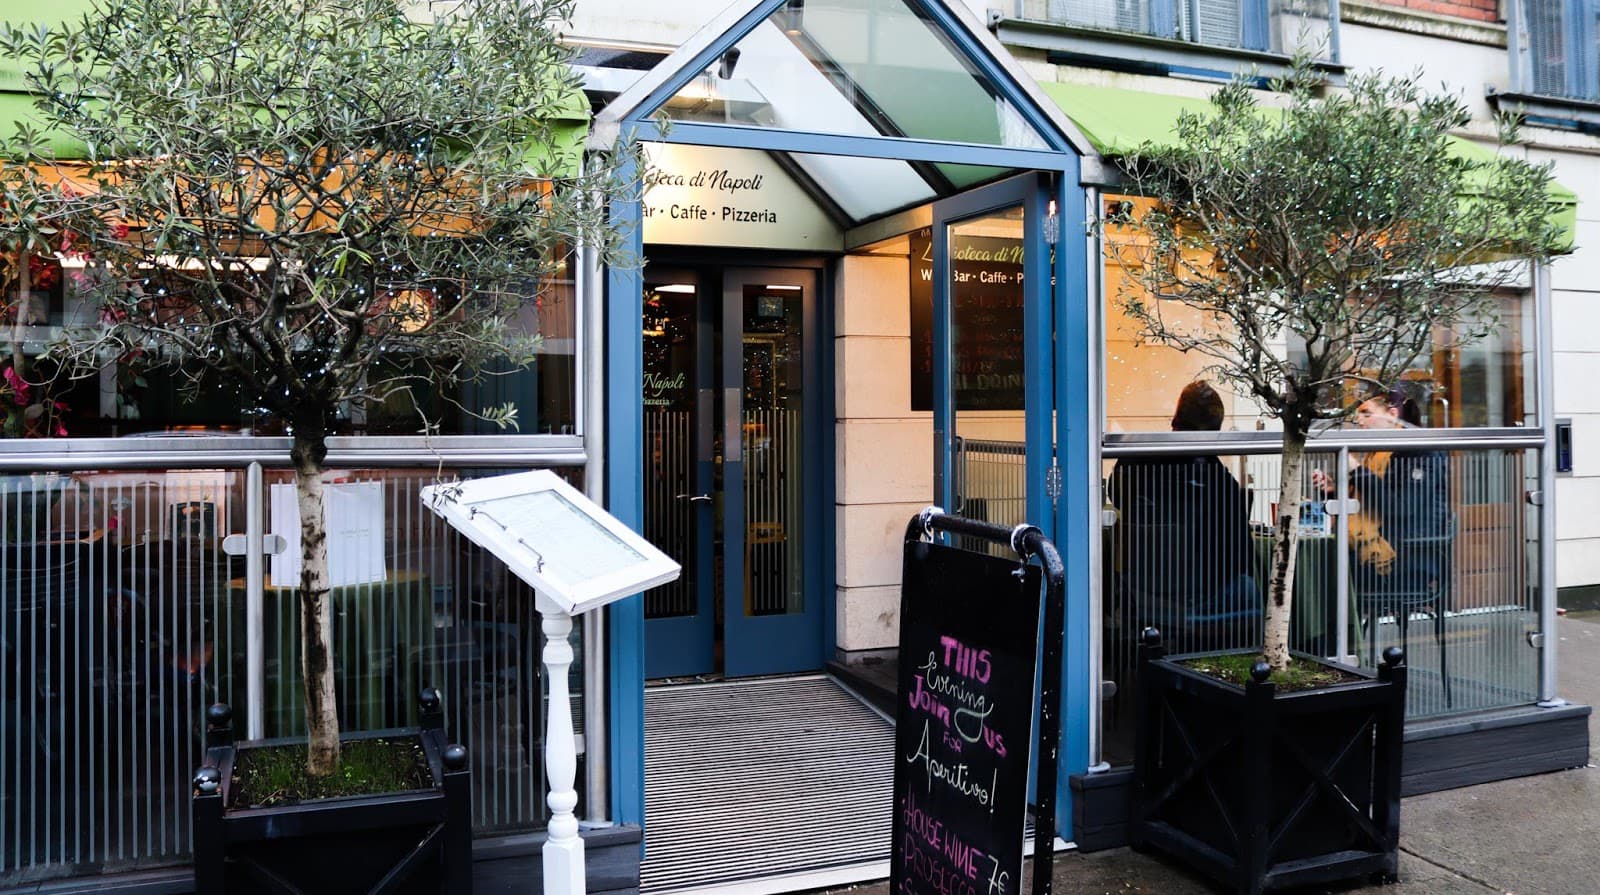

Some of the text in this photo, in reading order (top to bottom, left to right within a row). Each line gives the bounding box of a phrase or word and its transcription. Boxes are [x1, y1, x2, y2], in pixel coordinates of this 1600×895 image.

[689, 170, 706, 188] di
[708, 169, 763, 194] Napoli
[642, 204, 777, 223] ar Caffe Pizzeria
[994, 246, 1009, 262] di
[980, 270, 1007, 284] Caffe
[643, 371, 686, 397] Napoli
[940, 635, 993, 685] THIS
[904, 783, 944, 850] HOUSE
[944, 830, 986, 881] WINE
